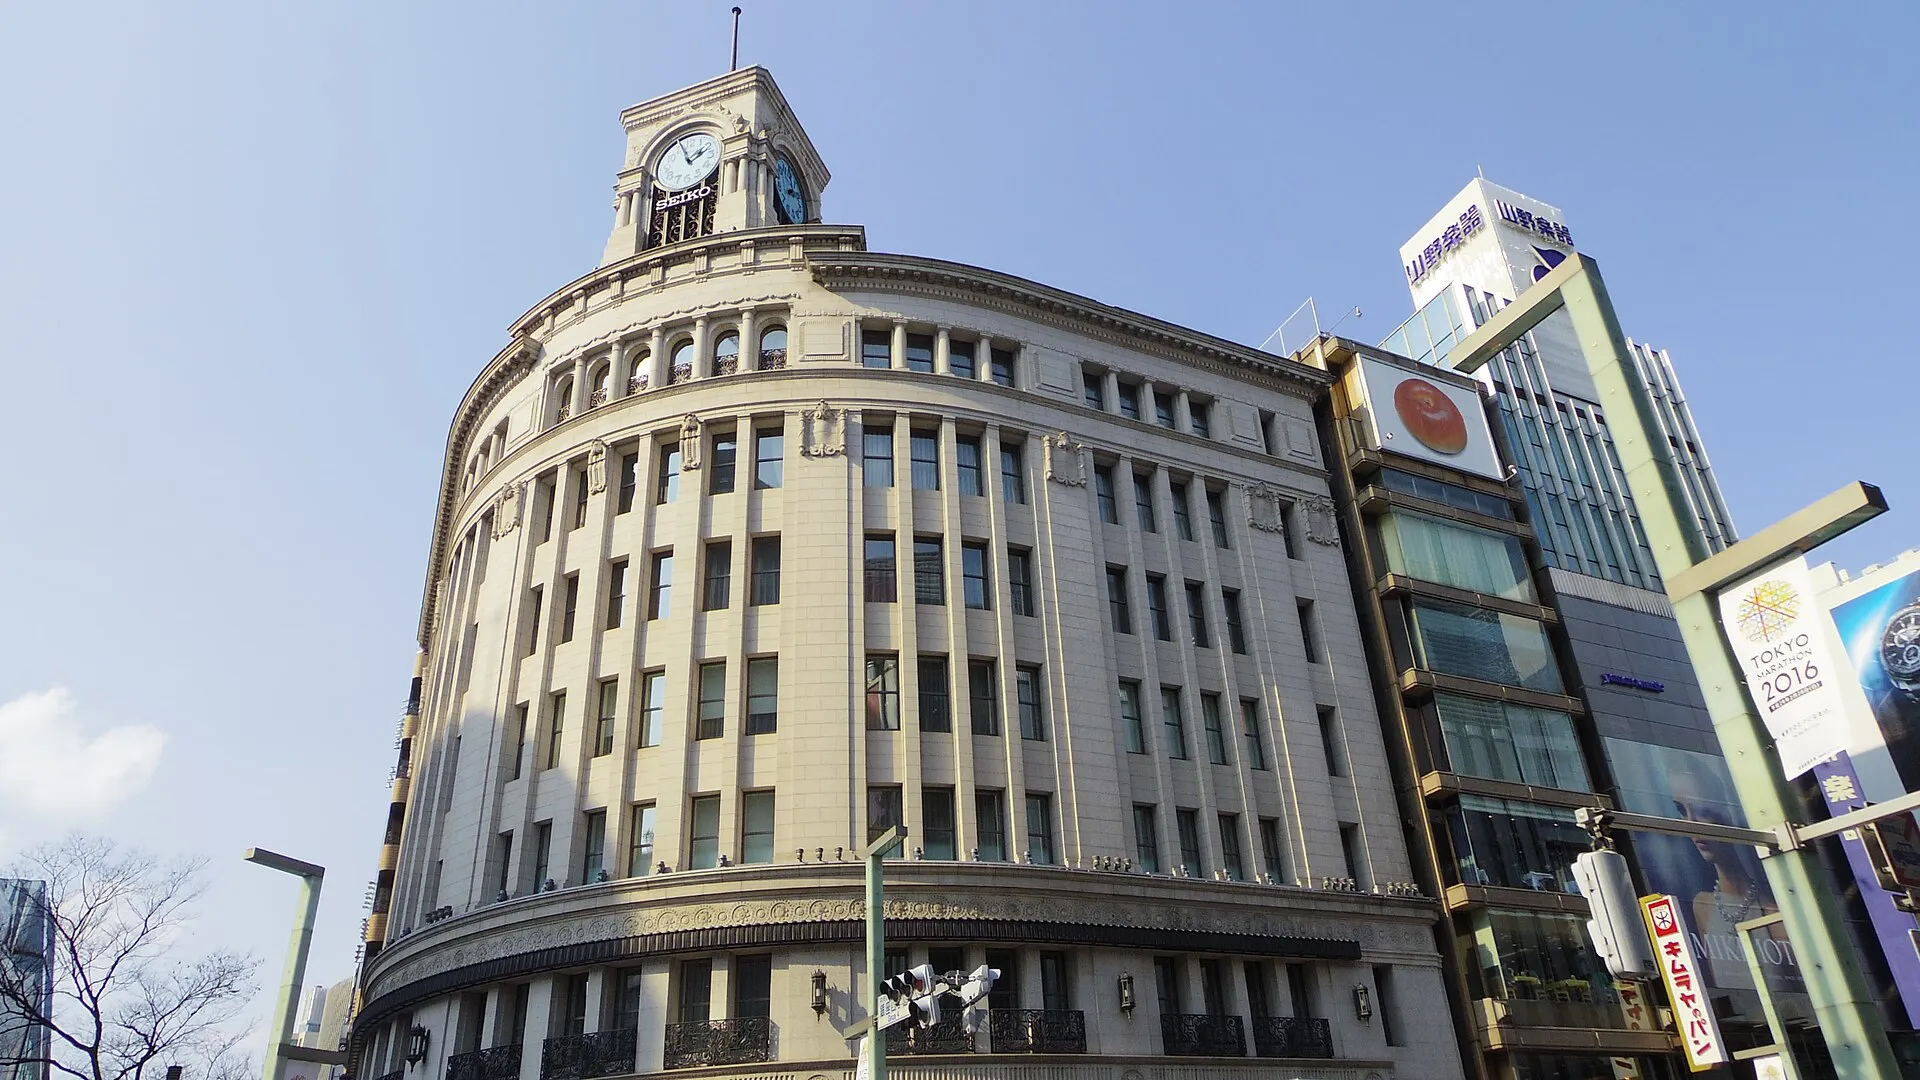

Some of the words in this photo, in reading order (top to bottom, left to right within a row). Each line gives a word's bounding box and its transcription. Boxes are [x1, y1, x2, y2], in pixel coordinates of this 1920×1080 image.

[655, 186, 711, 211] SEIKO
[1495, 199, 1575, 247] 山野楽器
[1405, 204, 1482, 285] 山野楽器
[1750, 633, 1809, 669] TOKYO
[1756, 648, 1813, 680] MARATHON
[1761, 660, 1819, 703] 2016
